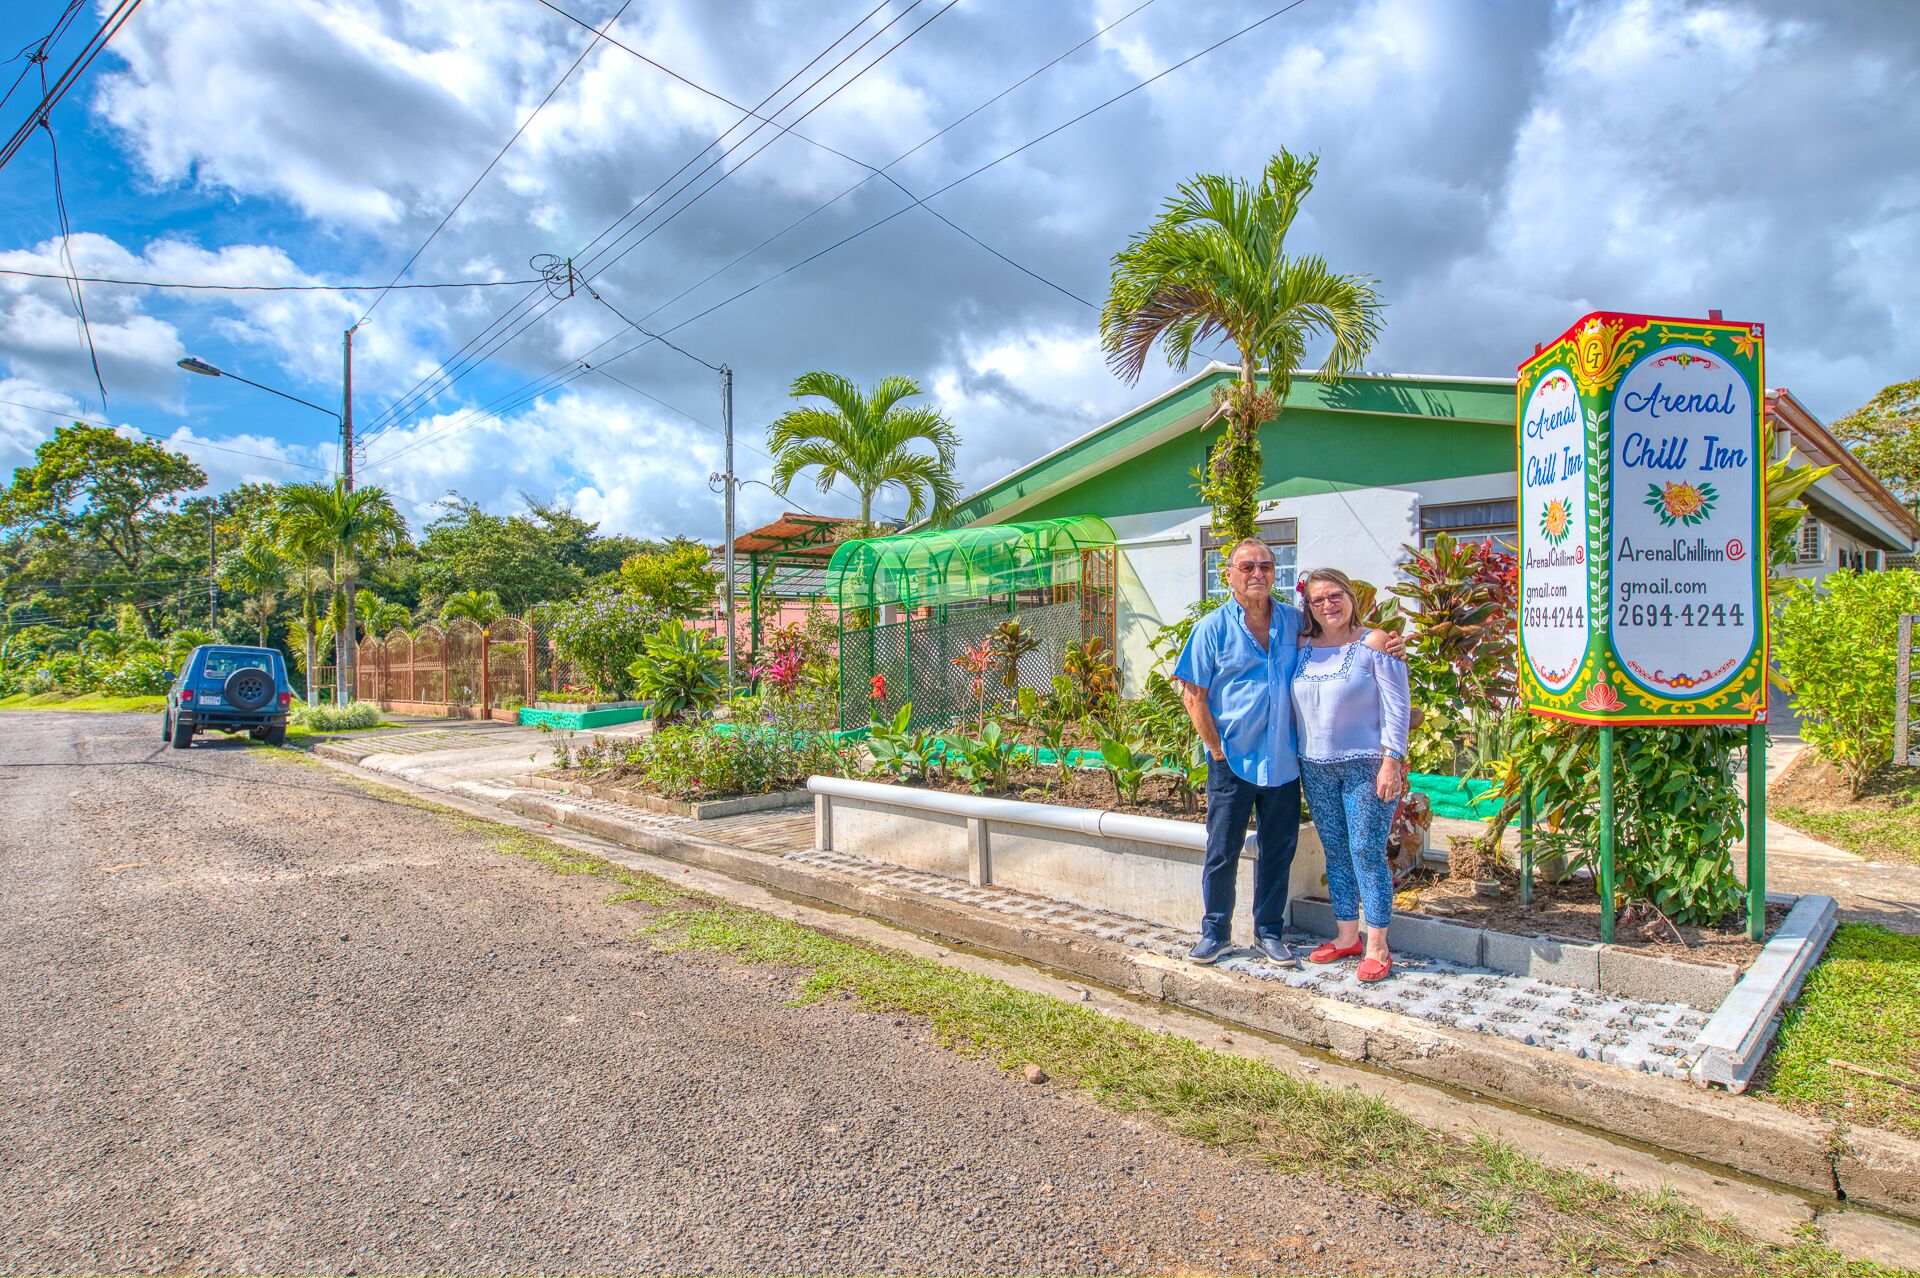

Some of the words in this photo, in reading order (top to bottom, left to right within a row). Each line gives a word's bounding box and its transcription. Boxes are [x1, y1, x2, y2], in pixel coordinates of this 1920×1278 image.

[1527, 393, 1577, 439] Arenal
[1624, 382, 1736, 418] Arenal
[1527, 452, 1557, 487] Chill
[1561, 446, 1583, 481] Inn
[1622, 432, 1688, 470] Chill
[1699, 435, 1747, 471] Inn
[1526, 582, 1567, 604] gmail.com
[1620, 578, 1707, 602] gmail.com
